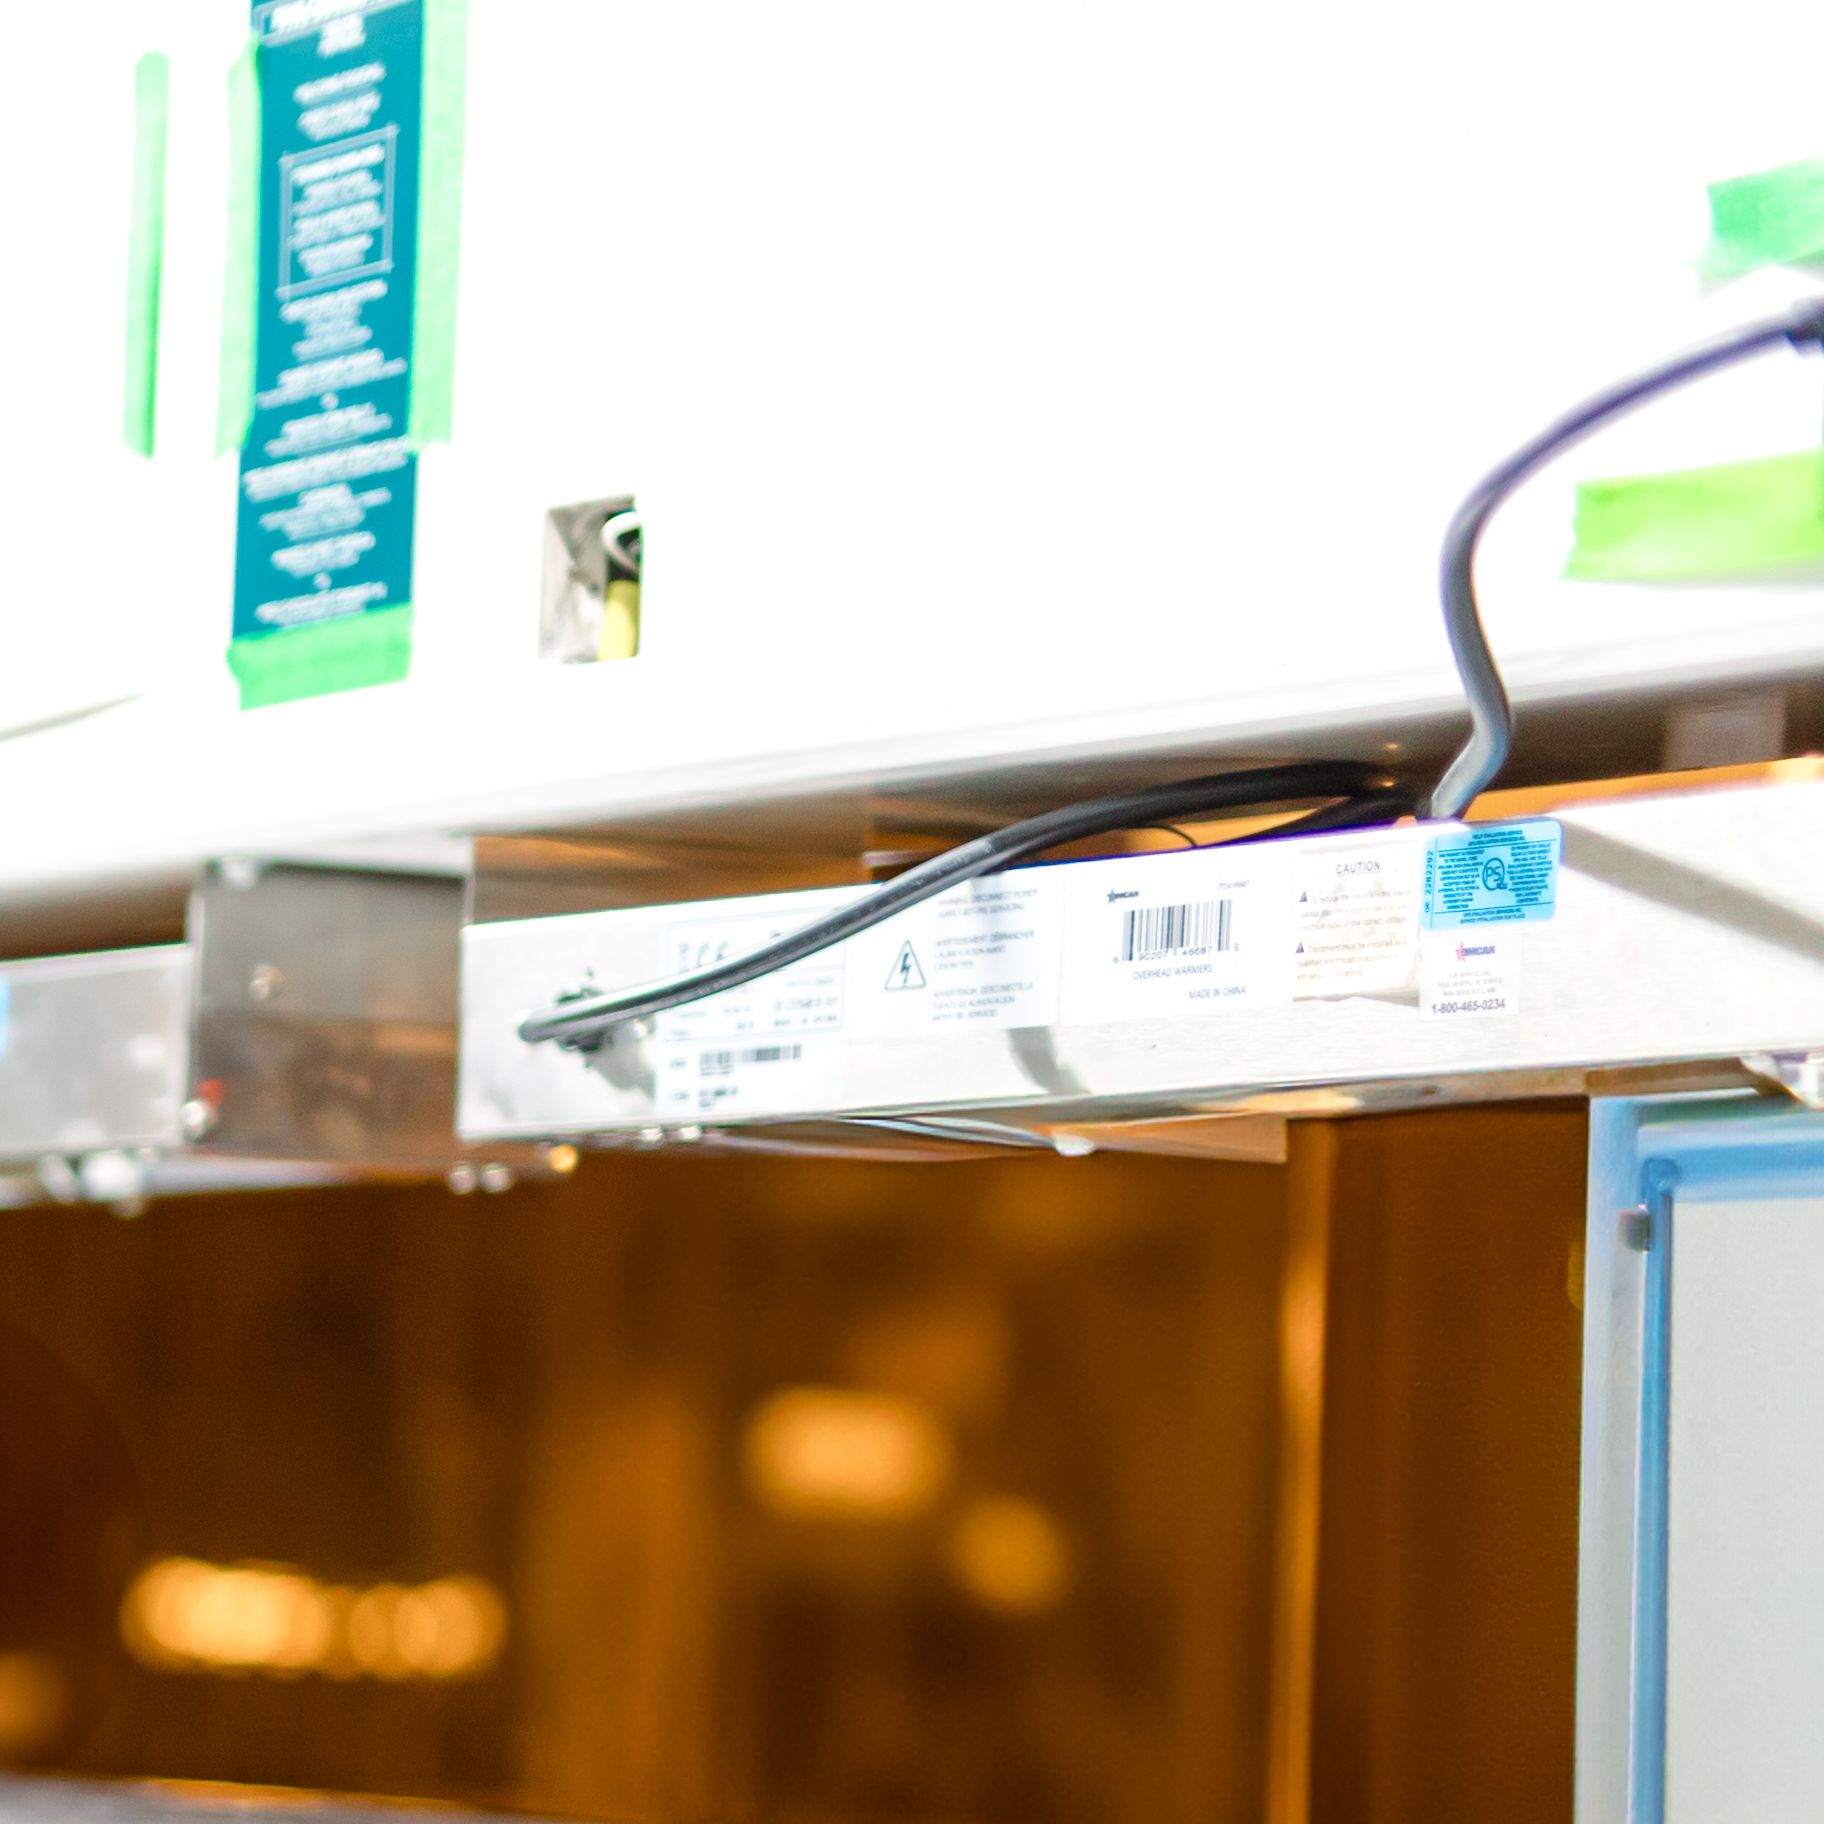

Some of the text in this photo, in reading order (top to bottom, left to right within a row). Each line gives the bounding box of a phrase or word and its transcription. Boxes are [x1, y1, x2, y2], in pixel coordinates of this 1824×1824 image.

[1336, 861, 1381, 875] CAUTION
[1133, 964, 1212, 981] OVERHEAD WARMERS
[1188, 986, 1246, 999] MADE IN CHINA
[1431, 998, 1506, 1015] 1-800-465-0234
